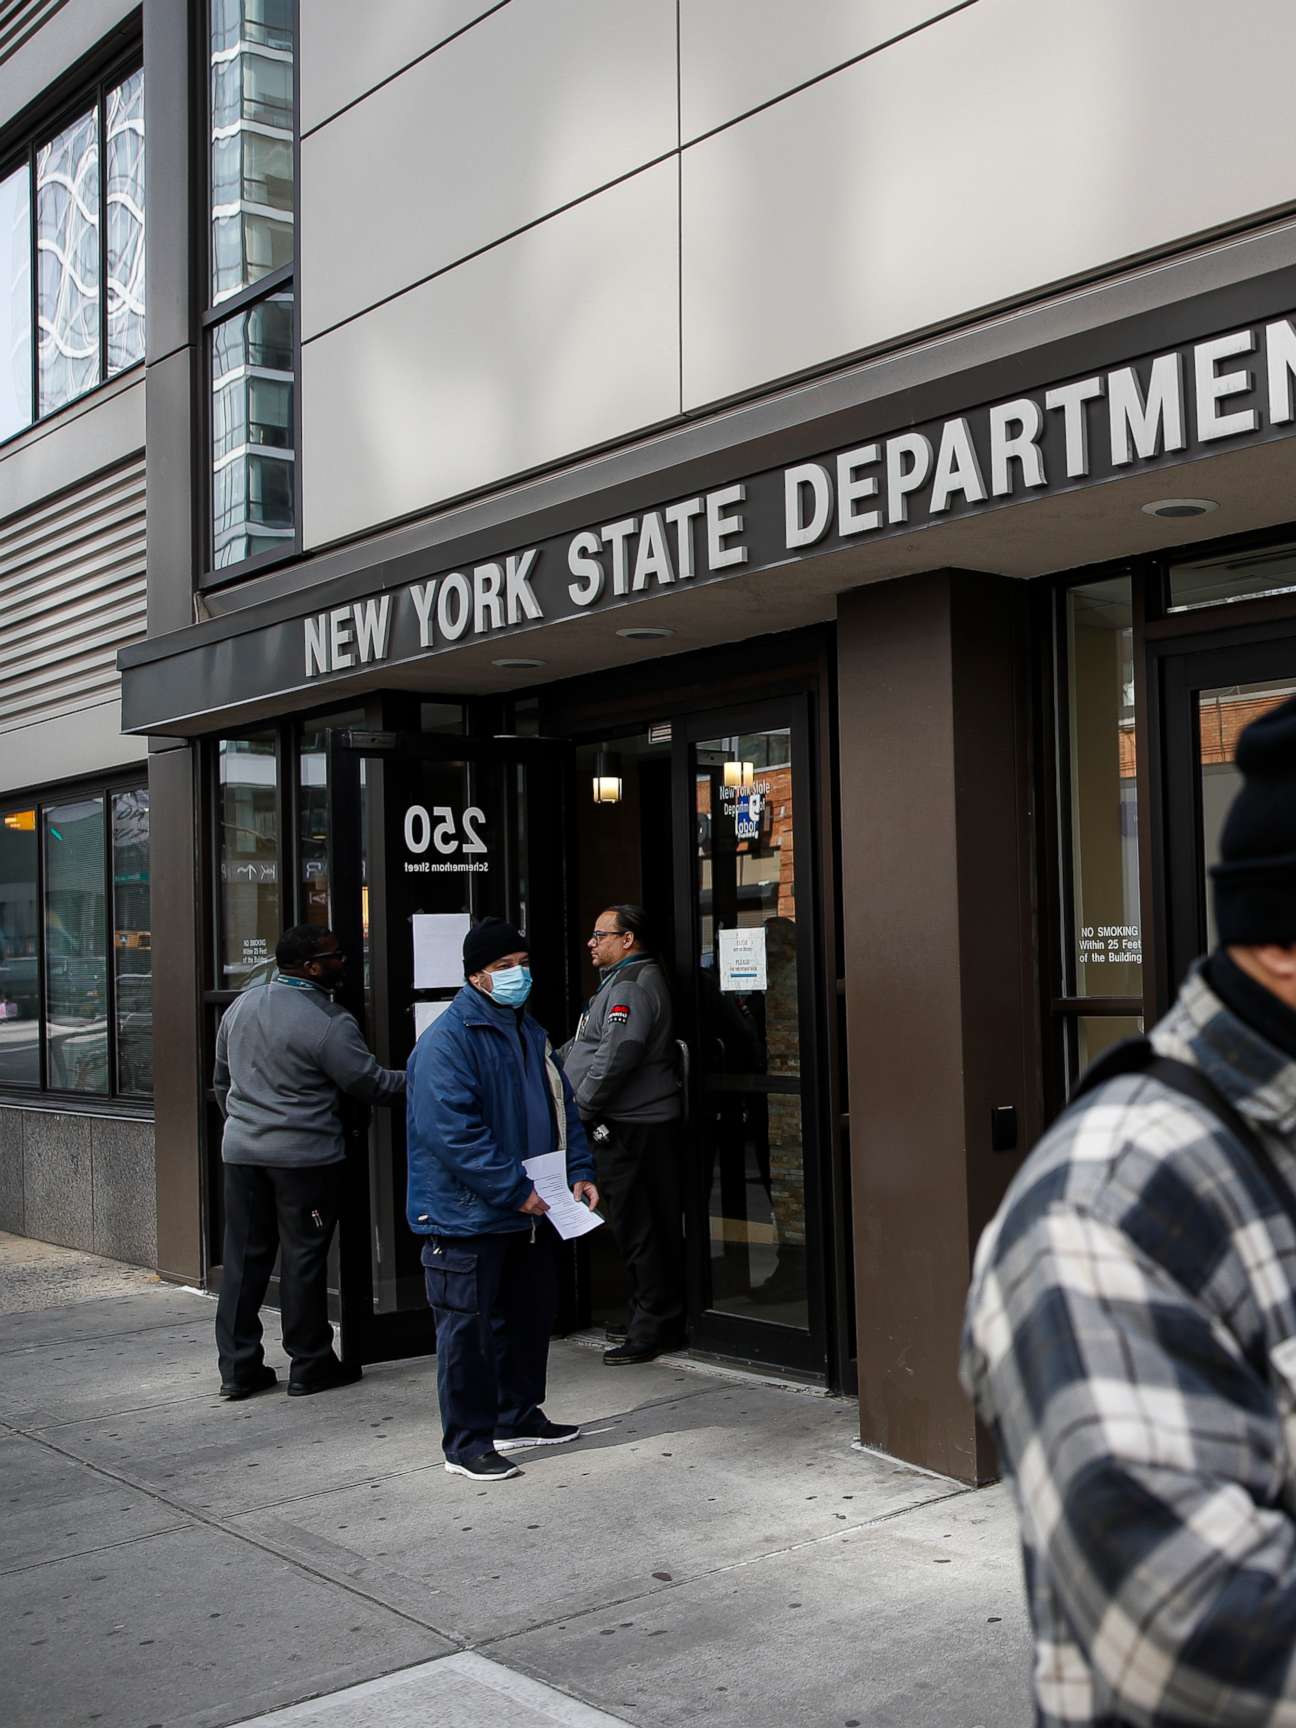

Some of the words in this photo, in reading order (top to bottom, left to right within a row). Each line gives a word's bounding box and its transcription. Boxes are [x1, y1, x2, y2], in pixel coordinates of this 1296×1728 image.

[304, 595, 391, 677] NEW
[409, 548, 544, 648] YORK
[567, 484, 748, 607] STATE
[720, 786, 735, 800] New
[1081, 927, 1094, 937] NO
[1097, 926, 1139, 937] SMOKING
[1079, 940, 1105, 950] Within
[1107, 939, 1119, 950] 25
[1122, 939, 1142, 949] Feet
[1079, 953, 1089, 963] of
[1092, 952, 1105, 962] the
[1108, 952, 1142, 964] Building
